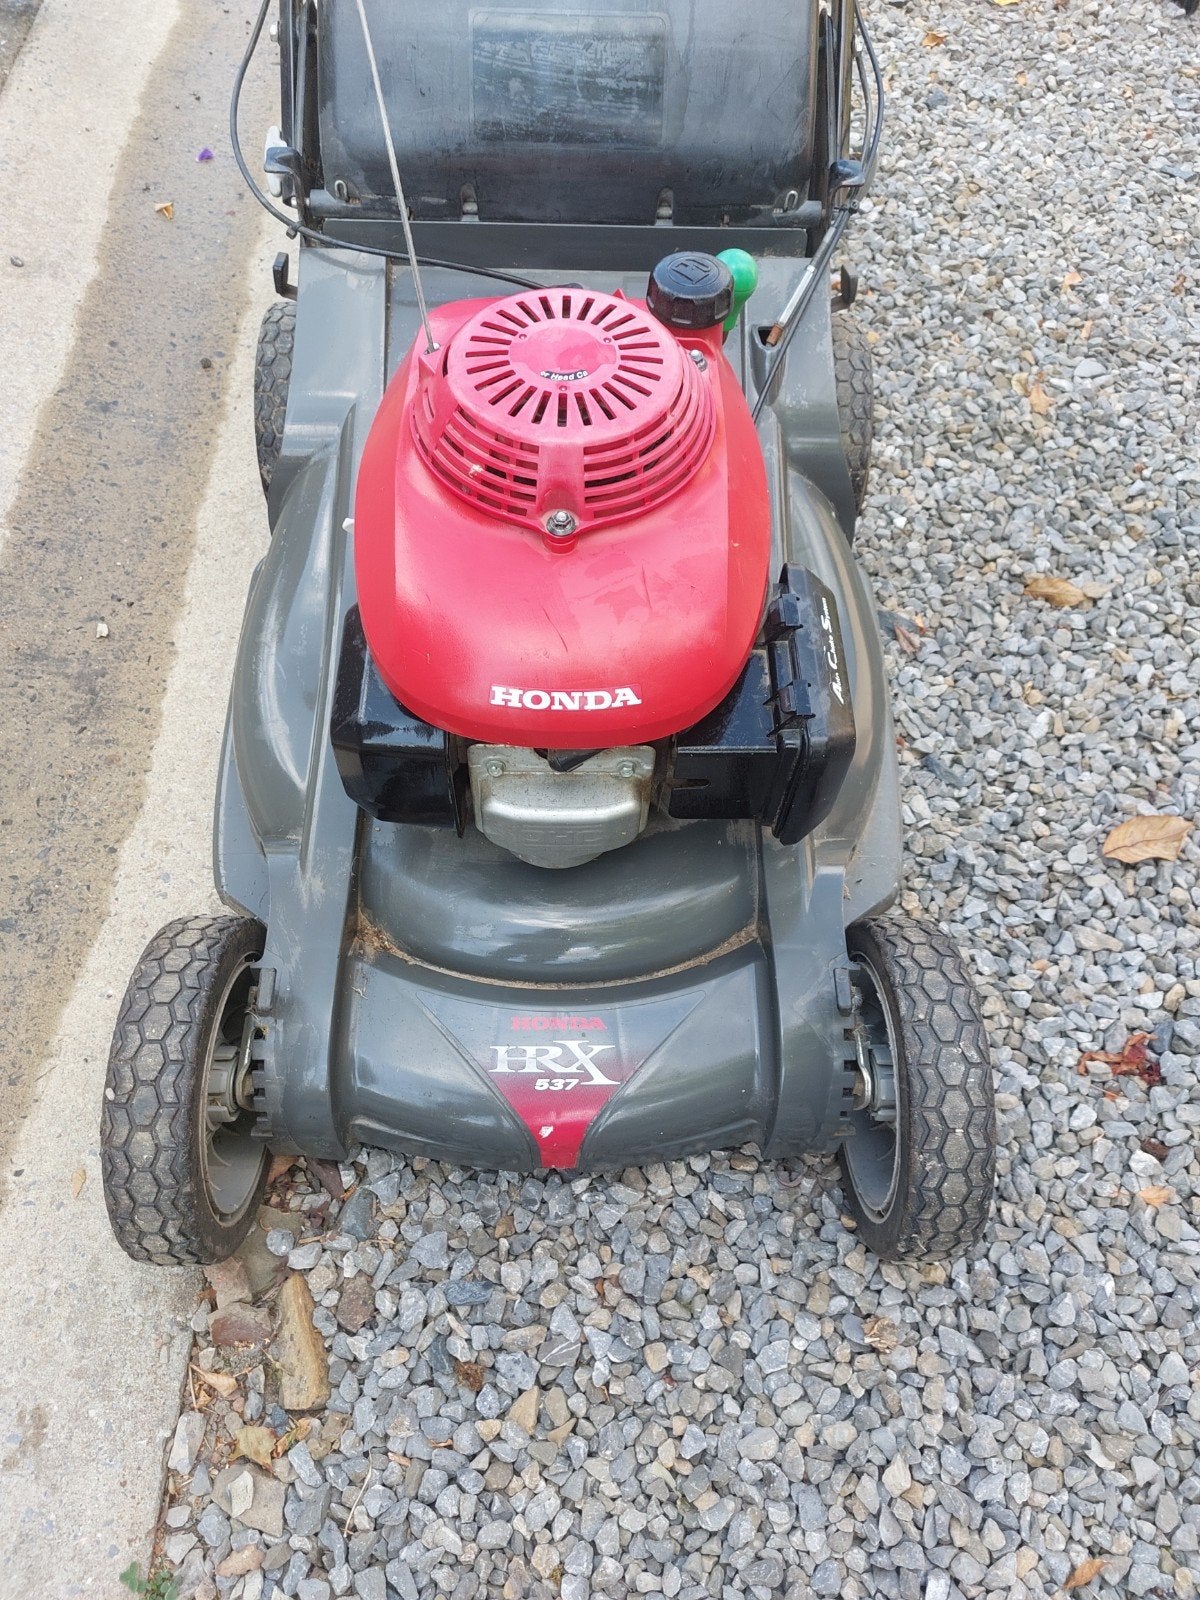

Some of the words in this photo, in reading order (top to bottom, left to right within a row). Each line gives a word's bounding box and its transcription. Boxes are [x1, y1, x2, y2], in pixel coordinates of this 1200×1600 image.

[551, 373, 575, 381] Head
[490, 685, 642, 710] HONDA
[511, 1016, 607, 1031] HONDA
[489, 1040, 621, 1085] HRX
[534, 1078, 580, 1091] 537
